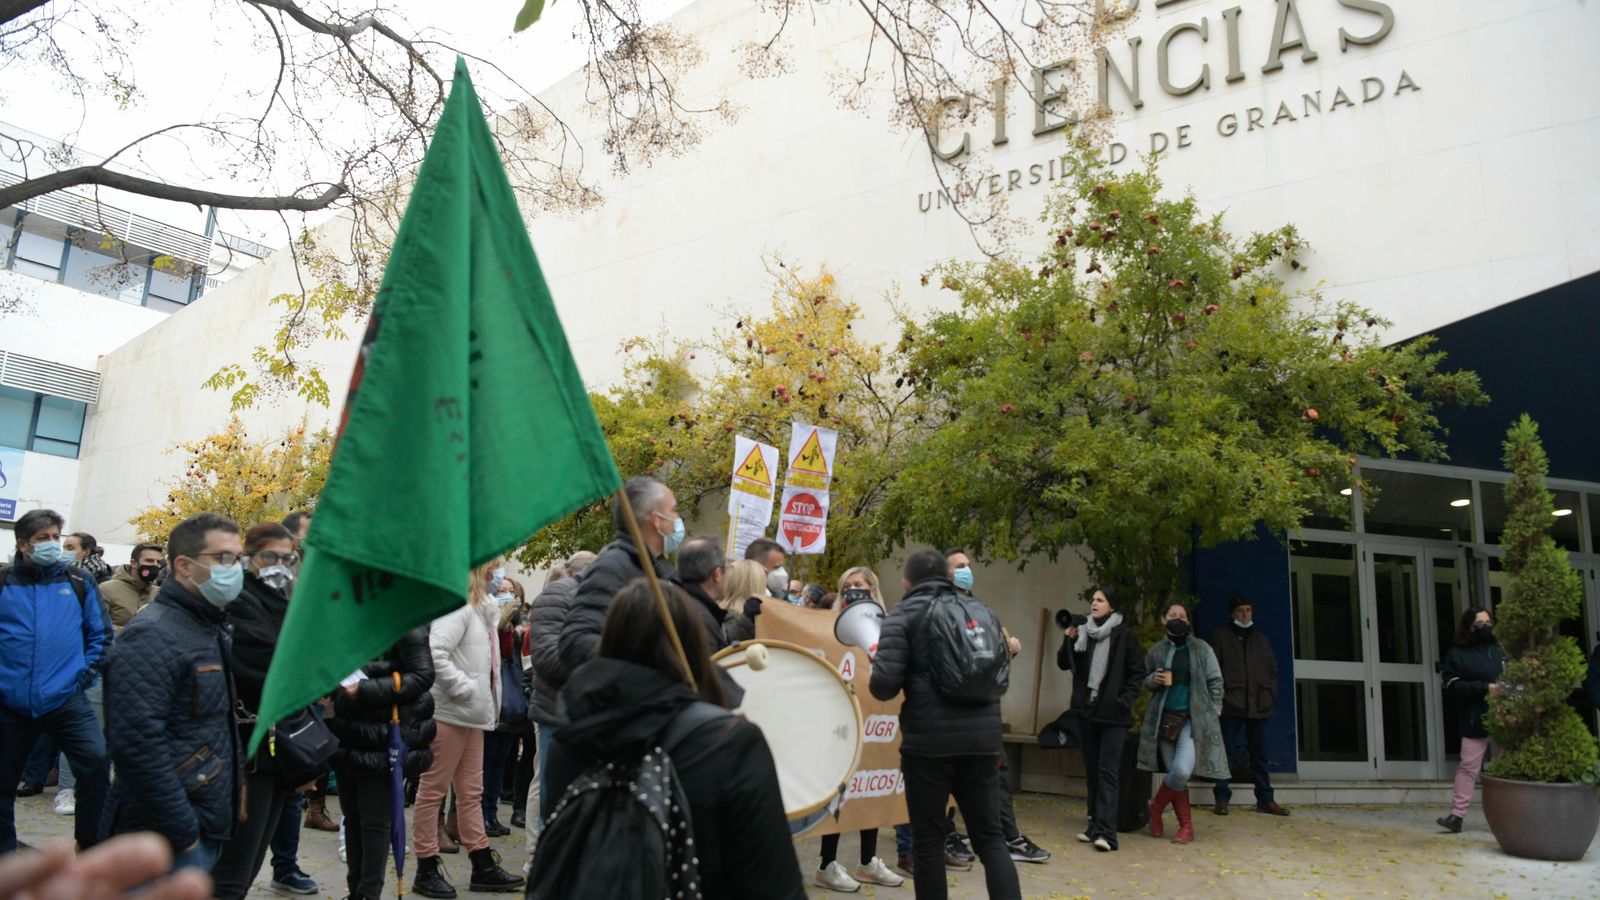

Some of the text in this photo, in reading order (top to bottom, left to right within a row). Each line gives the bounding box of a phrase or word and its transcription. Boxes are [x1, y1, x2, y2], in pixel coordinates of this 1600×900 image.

[927, 0, 1396, 161] CIENCIAS
[917, 69, 1422, 213] UNIVERSIDD DE GRANADA
[791, 502, 815, 515] STOP
[841, 659, 852, 676] A
[864, 720, 895, 737] UGR
